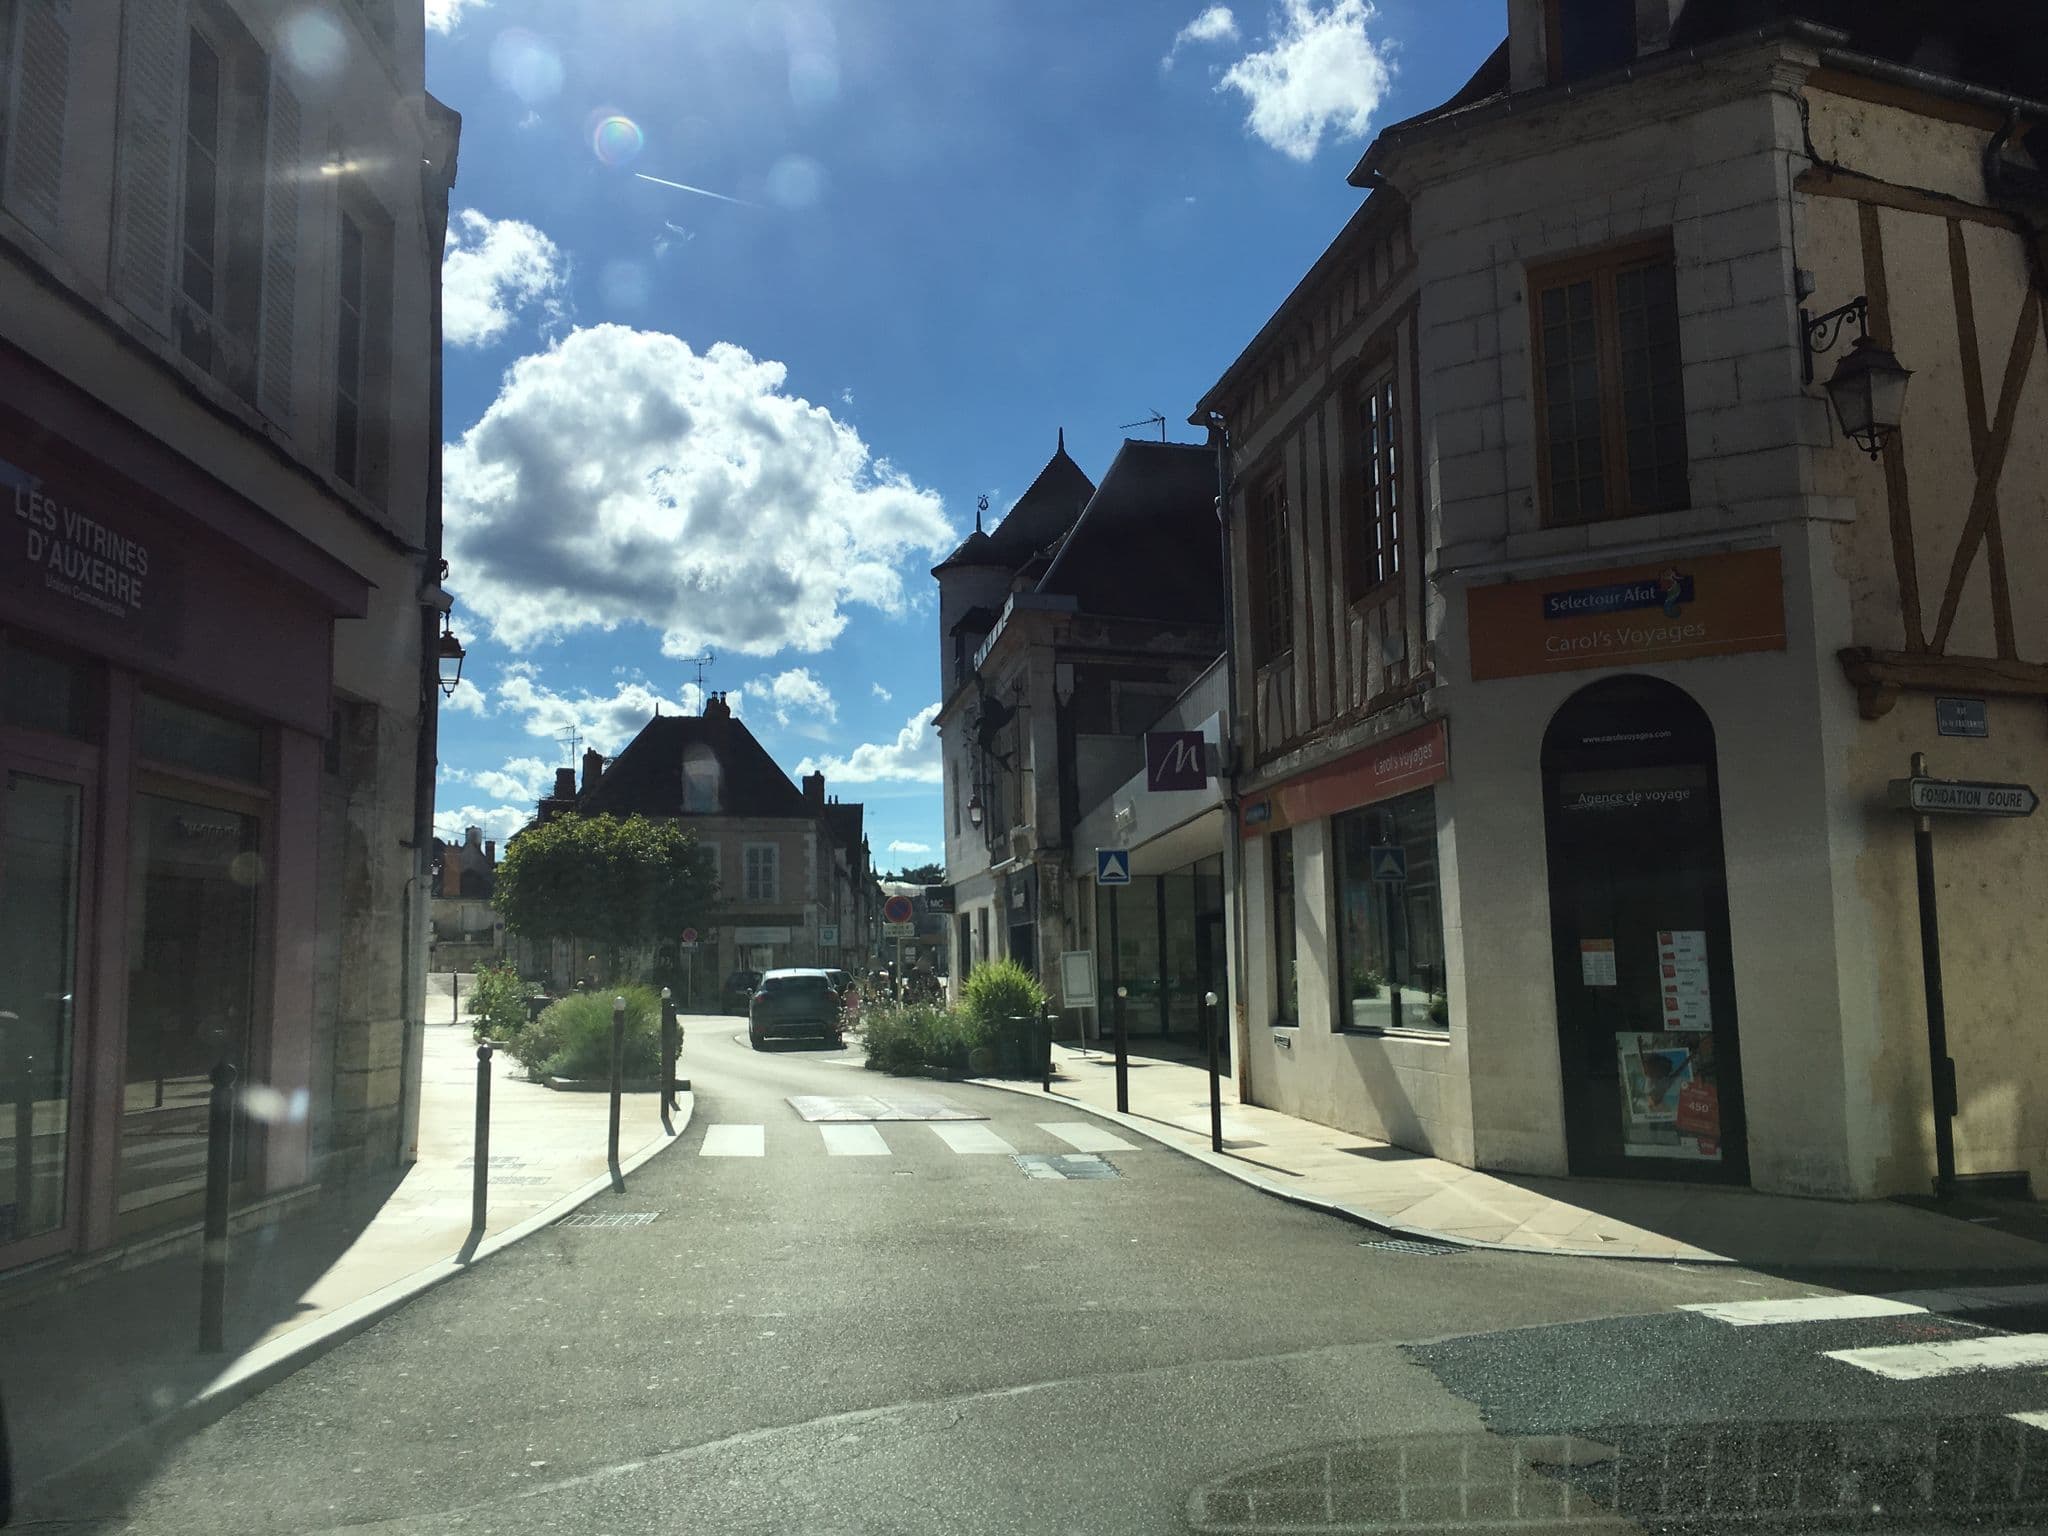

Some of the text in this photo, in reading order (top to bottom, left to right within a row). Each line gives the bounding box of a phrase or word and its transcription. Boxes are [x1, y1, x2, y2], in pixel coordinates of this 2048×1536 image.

[15, 484, 148, 577] LES VITRINES
[27, 528, 145, 609] D'AUXERRE
[1551, 586, 1656, 612] Selectour Afat
[1545, 623, 1705, 653] Carol's Voyages
[1399, 742, 1433, 770] Voyages
[1578, 788, 1690, 807] Agence de voyage
[1921, 788, 1981, 806] FONDATION
